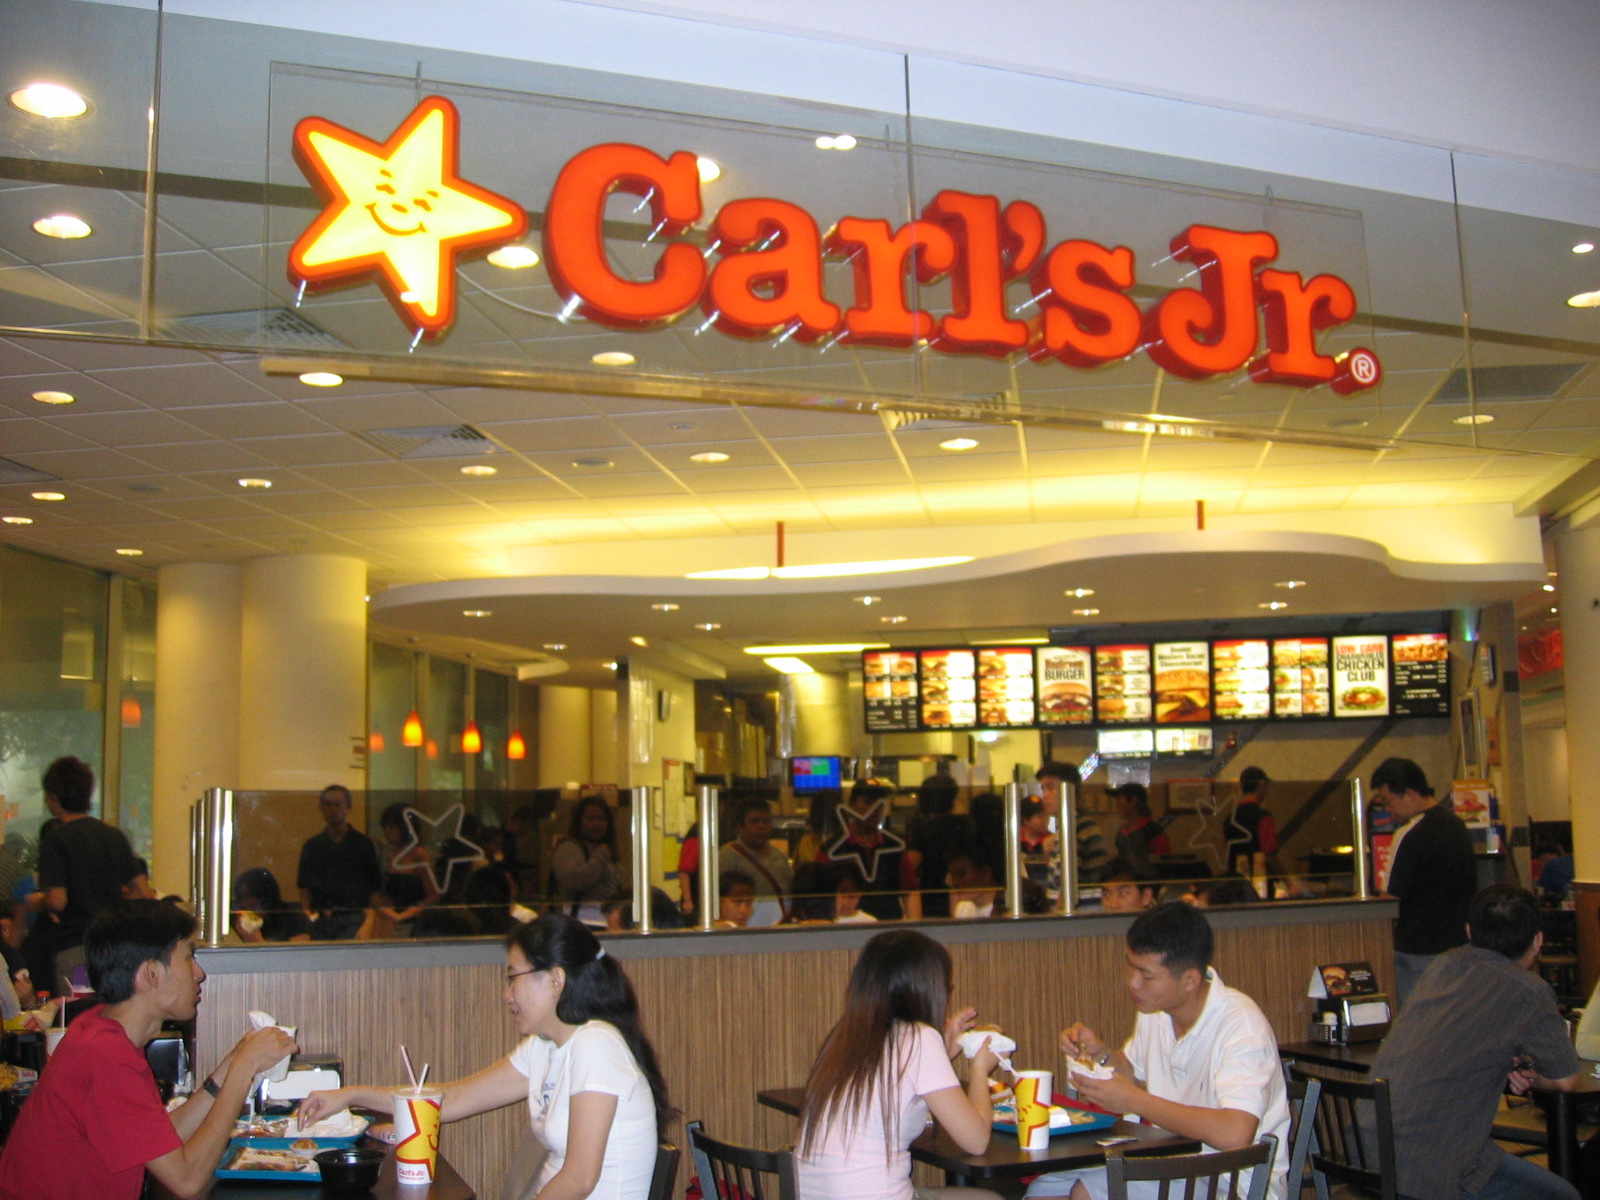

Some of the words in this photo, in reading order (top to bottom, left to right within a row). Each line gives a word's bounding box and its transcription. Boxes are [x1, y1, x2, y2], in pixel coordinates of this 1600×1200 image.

[543, 142, 1142, 368] Carl's
[1336, 644, 1355, 655] LOW
[1360, 643, 1384, 653] CARB
[1336, 658, 1384, 671] CHICKEN
[1045, 669, 1085, 680] BURGER
[1347, 670, 1376, 682] CLUB
